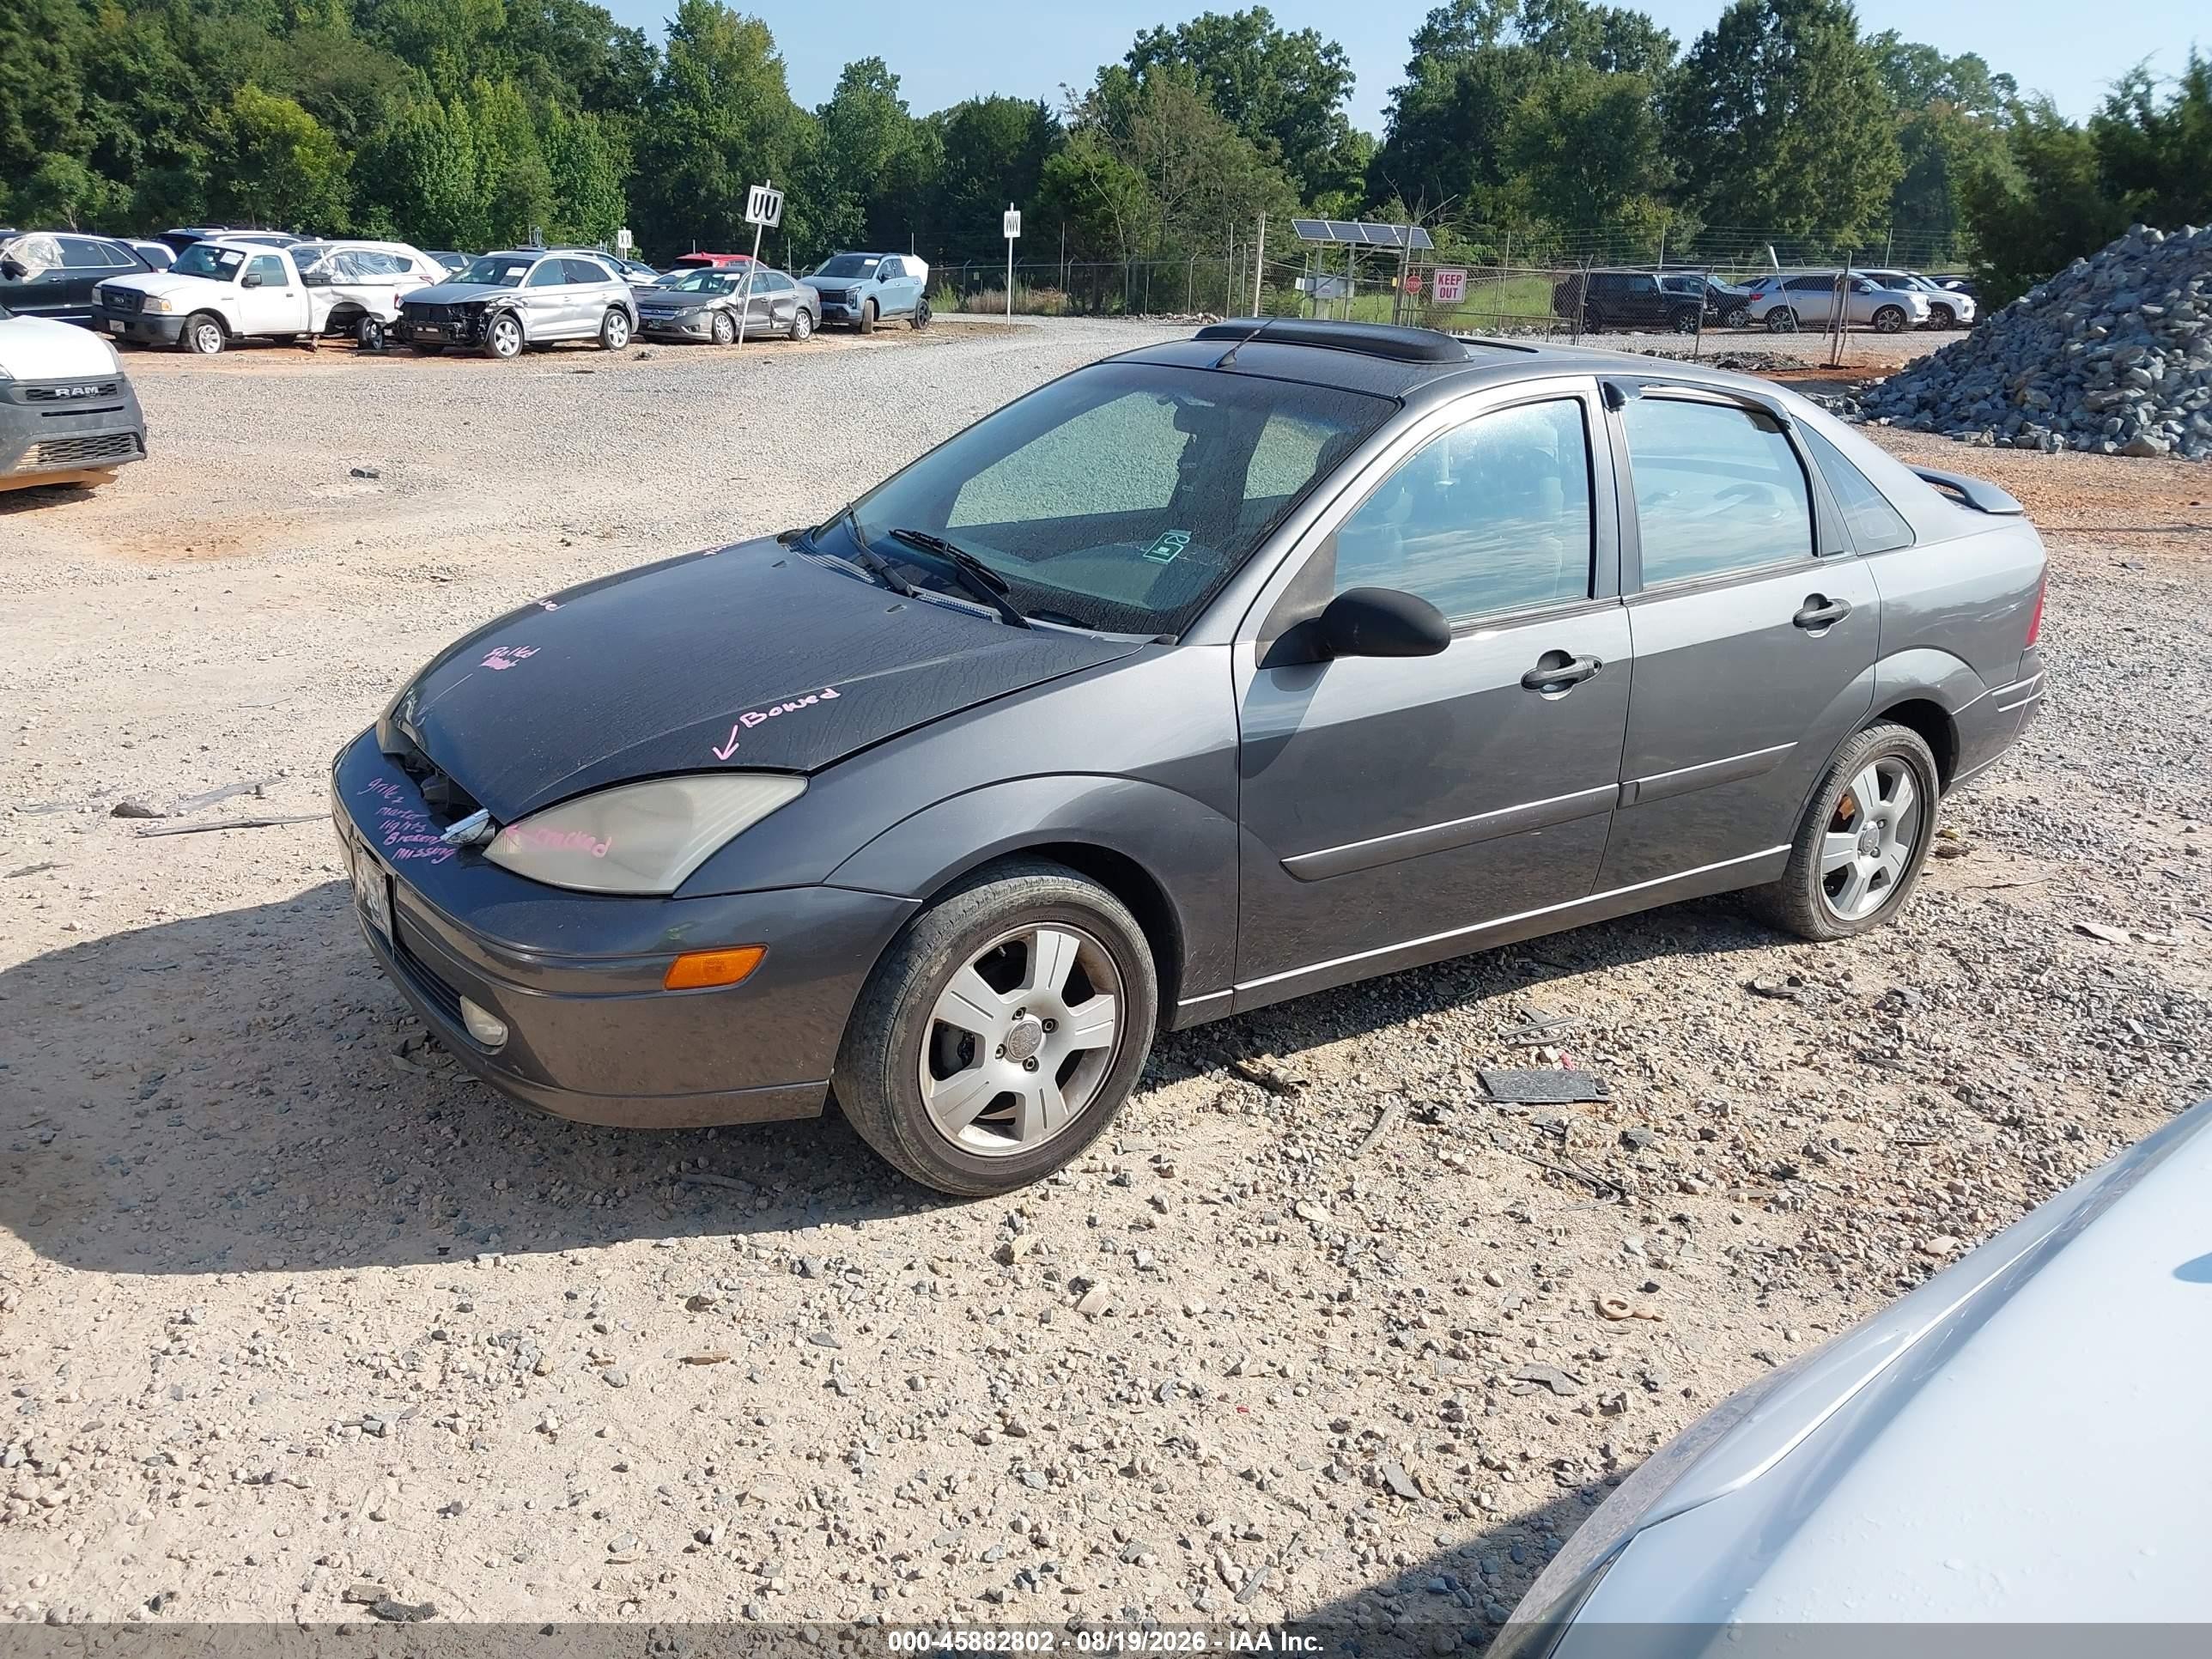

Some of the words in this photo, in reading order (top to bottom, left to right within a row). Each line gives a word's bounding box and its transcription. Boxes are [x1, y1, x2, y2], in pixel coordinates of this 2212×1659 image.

[753, 193, 778, 221] UU
[620, 233, 630, 246] XX
[1438, 274, 1462, 285] KEEP
[1439, 288, 1458, 298] OUT
[55, 386, 100, 397] RAM
[739, 687, 842, 728] Bowed
